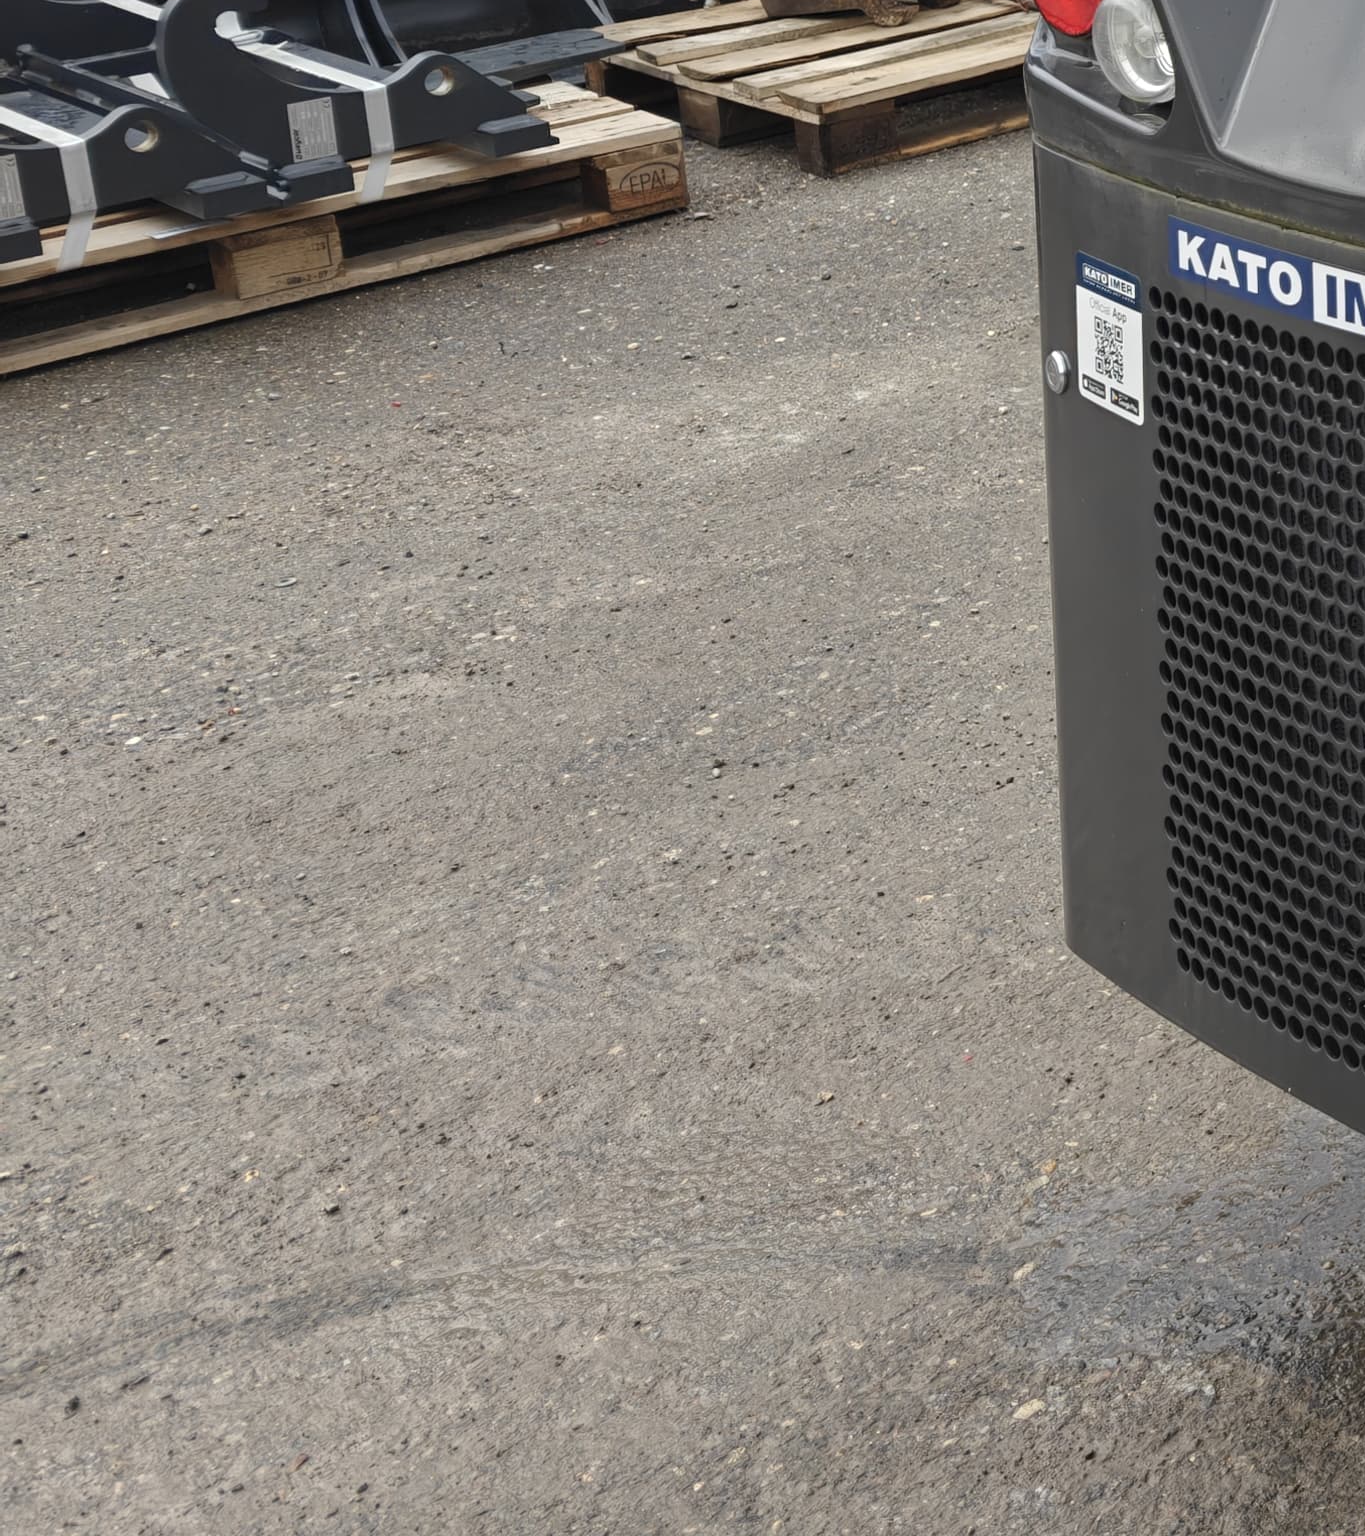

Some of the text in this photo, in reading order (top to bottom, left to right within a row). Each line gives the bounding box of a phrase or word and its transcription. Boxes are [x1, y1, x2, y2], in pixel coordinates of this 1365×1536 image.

[1084, 266, 1107, 285] KATO
[1110, 277, 1133, 296] IMER
[1177, 228, 1303, 308] KATO
